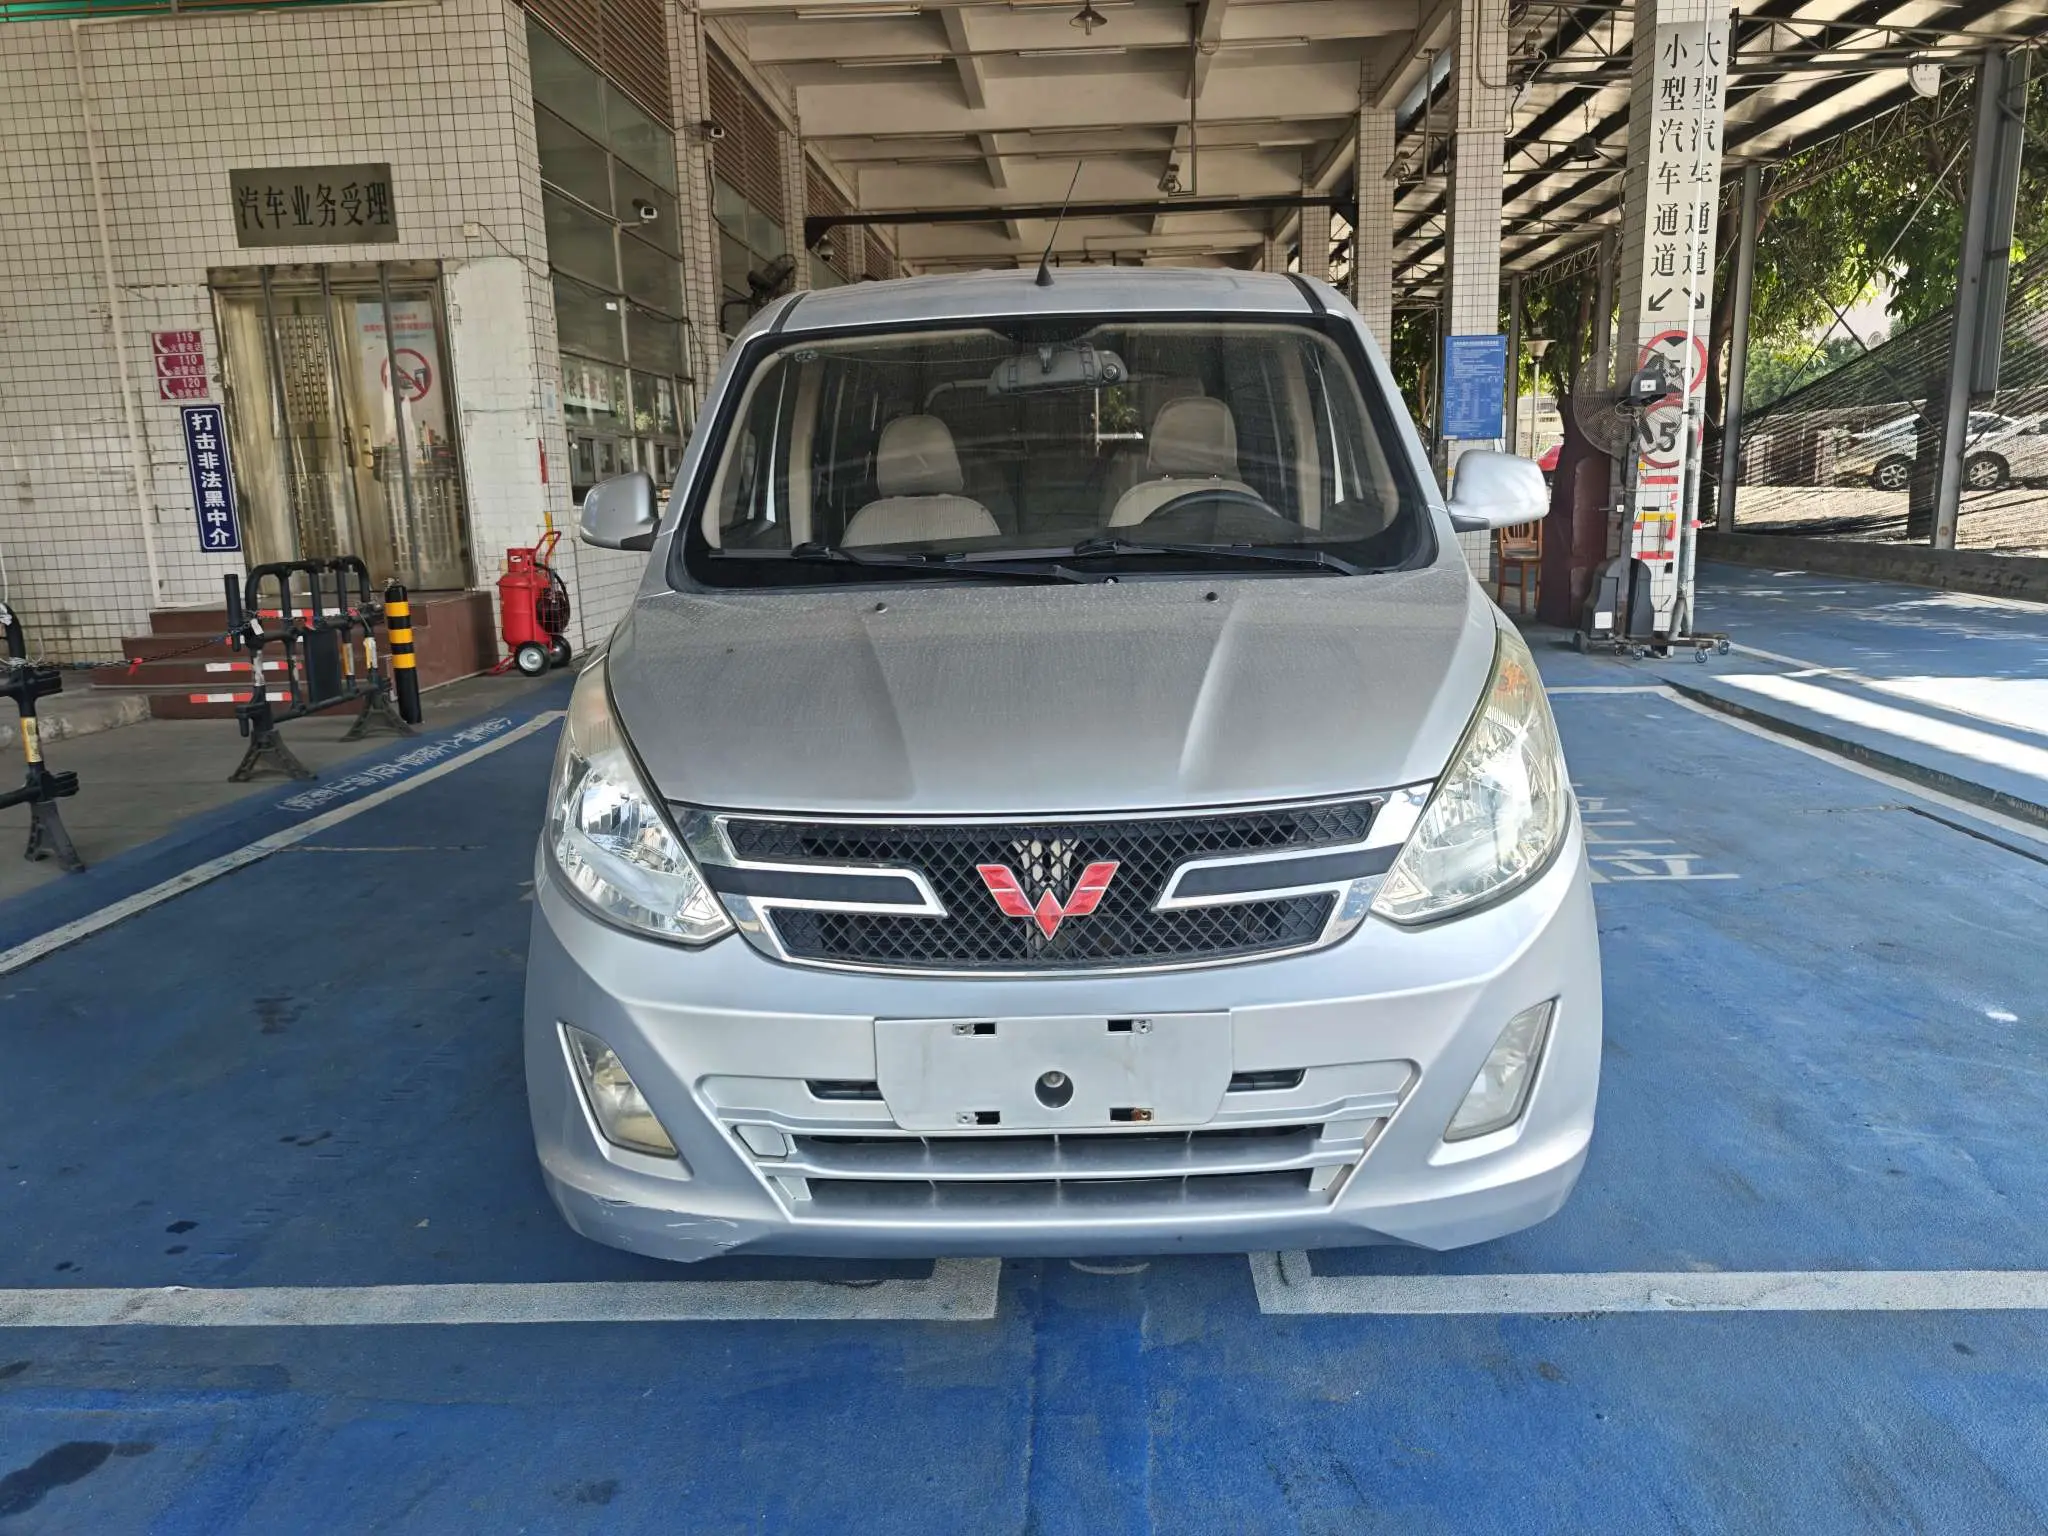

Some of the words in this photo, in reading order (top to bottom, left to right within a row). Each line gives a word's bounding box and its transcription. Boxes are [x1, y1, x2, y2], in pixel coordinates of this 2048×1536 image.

[1650, 33, 1688, 277] 小型汽车通道
[1682, 32, 1721, 276] 大型汽车通道
[238, 182, 391, 230] 汽车业务受理
[176, 332, 194, 342] 119
[180, 354, 197, 365] 110
[183, 378, 200, 388] 120
[191, 413, 231, 545] 打击非法黑中介
